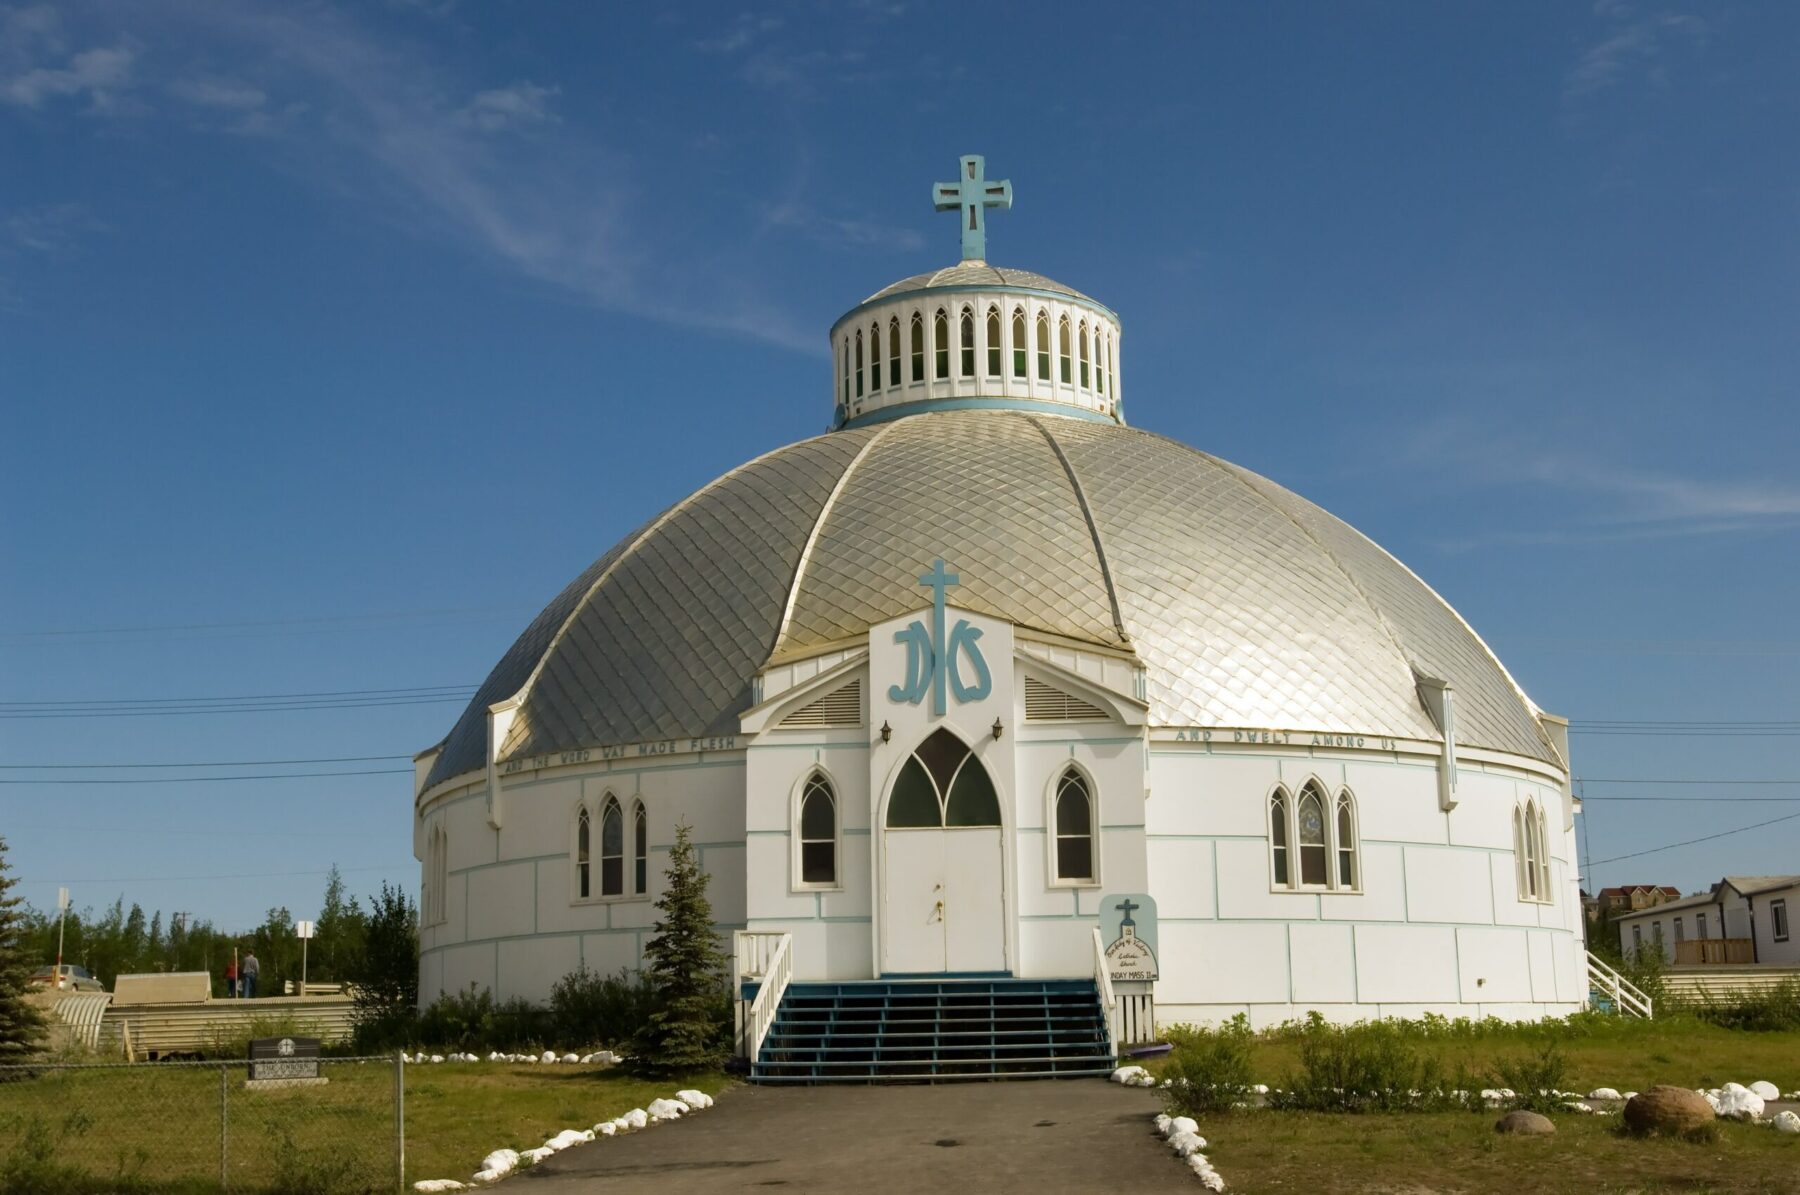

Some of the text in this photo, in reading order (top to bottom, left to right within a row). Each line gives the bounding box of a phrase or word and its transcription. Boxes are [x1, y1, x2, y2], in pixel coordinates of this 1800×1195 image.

[1175, 729, 1397, 751] AND DWELT AMONG US
[505, 737, 735, 774] AND THE WORD WAS MADE FLESH
[1128, 971, 1144, 979] MASS
